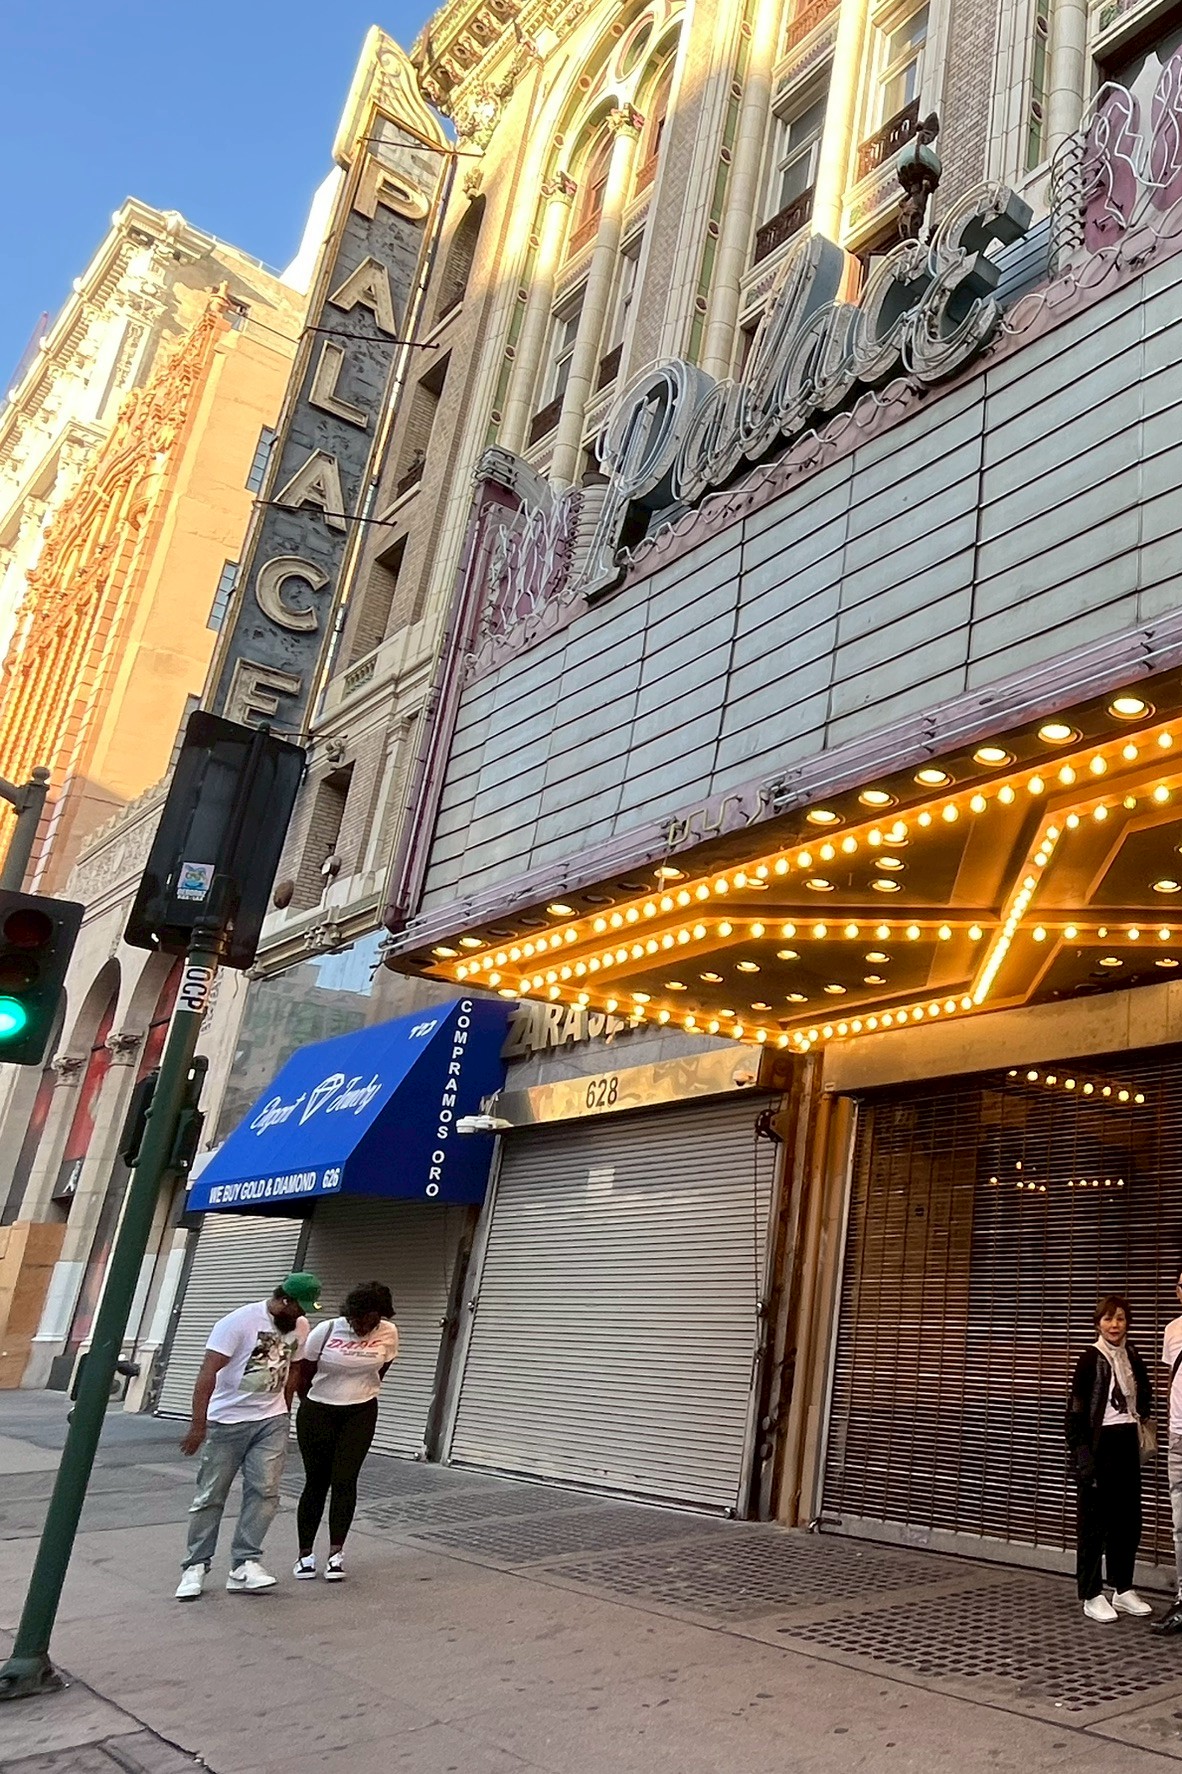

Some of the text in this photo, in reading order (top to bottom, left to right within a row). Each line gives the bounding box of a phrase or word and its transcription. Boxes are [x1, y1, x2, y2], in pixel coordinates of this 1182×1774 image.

[222, 152, 430, 742] PALACE
[437, 1000, 473, 1139] COMPRAMOS
[586, 1076, 618, 1109] 628
[209, 1168, 340, 1203] WE BUY GOLD & DIAMOND 626
[426, 1150, 446, 1197] ORO
